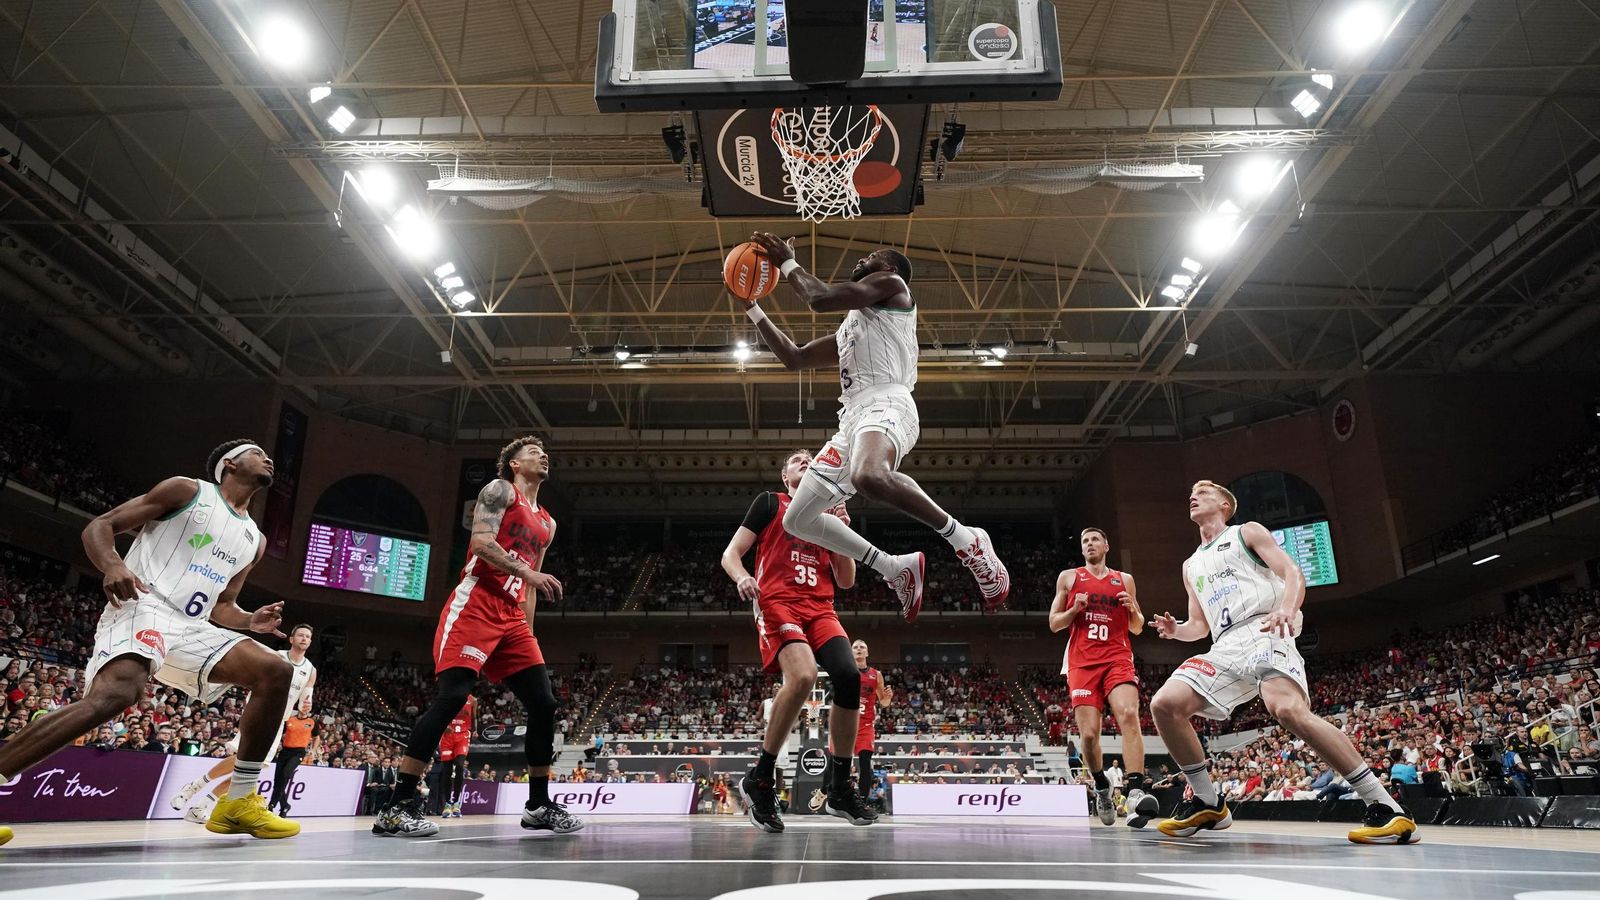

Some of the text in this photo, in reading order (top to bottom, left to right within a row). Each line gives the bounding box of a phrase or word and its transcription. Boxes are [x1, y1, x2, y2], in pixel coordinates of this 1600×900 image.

[738, 138, 754, 172] Murcia
[754, 260, 769, 296] Wilson
[350, 552, 361, 561] 25
[359, 564, 378, 573] 6:44
[379, 556, 390, 565] 22
[503, 574, 523, 599] 12
[794, 564, 818, 587] 35
[185, 591, 209, 617] 6
[1088, 623, 1109, 641] 20
[33, 768, 65, 798] Tu
[63, 772, 118, 797] tren
[553, 786, 616, 811] renfe
[958, 787, 1021, 813] renfe
